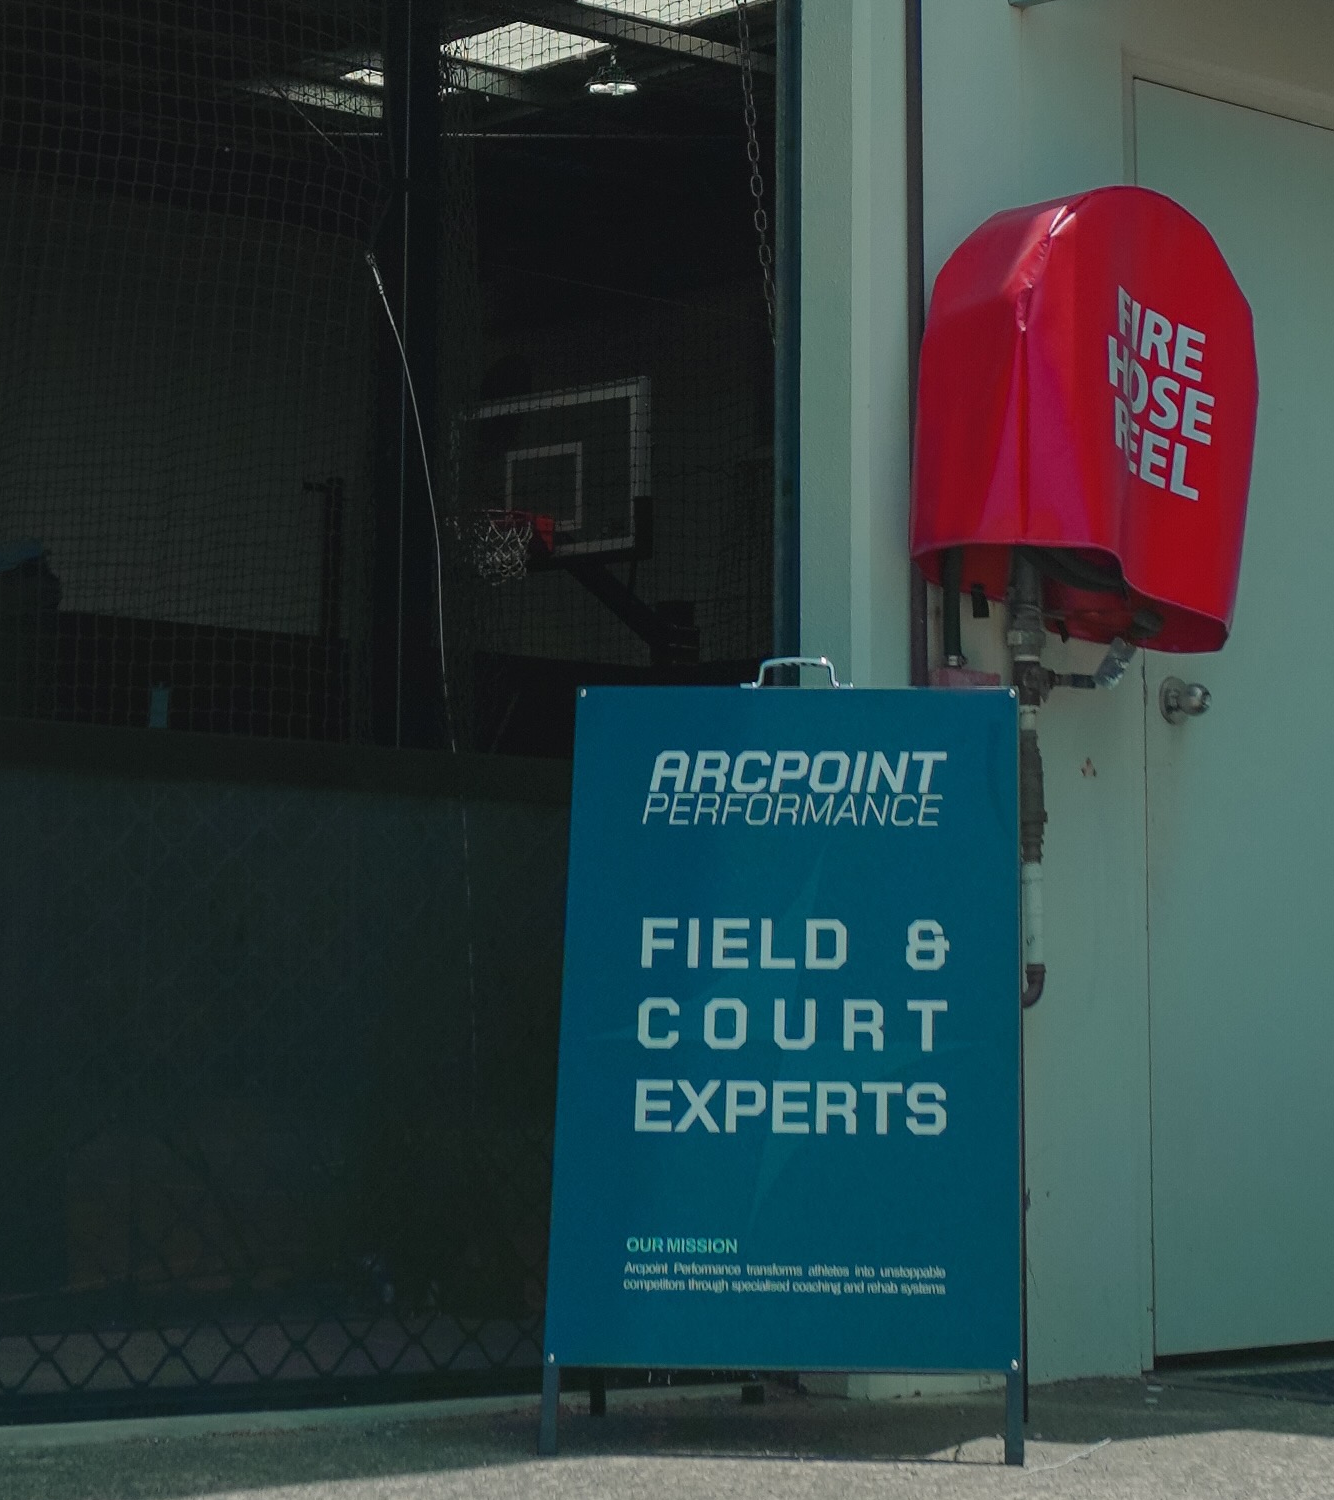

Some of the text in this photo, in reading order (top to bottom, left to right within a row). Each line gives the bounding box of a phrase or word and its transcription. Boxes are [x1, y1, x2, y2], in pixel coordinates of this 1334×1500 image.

[1118, 285, 1206, 383] FIRE
[1108, 335, 1215, 446] HOSE
[1115, 396, 1199, 501] REEL
[650, 750, 948, 794] ARCPOINT
[642, 793, 942, 826] PERFORMANCE
[641, 917, 950, 971] FIELD &
[637, 997, 948, 1052] COURT
[634, 1079, 947, 1136] EXPERTS
[624, 1261, 946, 1280] Arcpoint Performance transforms athletes into unstoppable
[626, 1236, 738, 1254] OUR MISSION
[623, 1278, 946, 1297] competitors through specialised coaching and rehab systems
